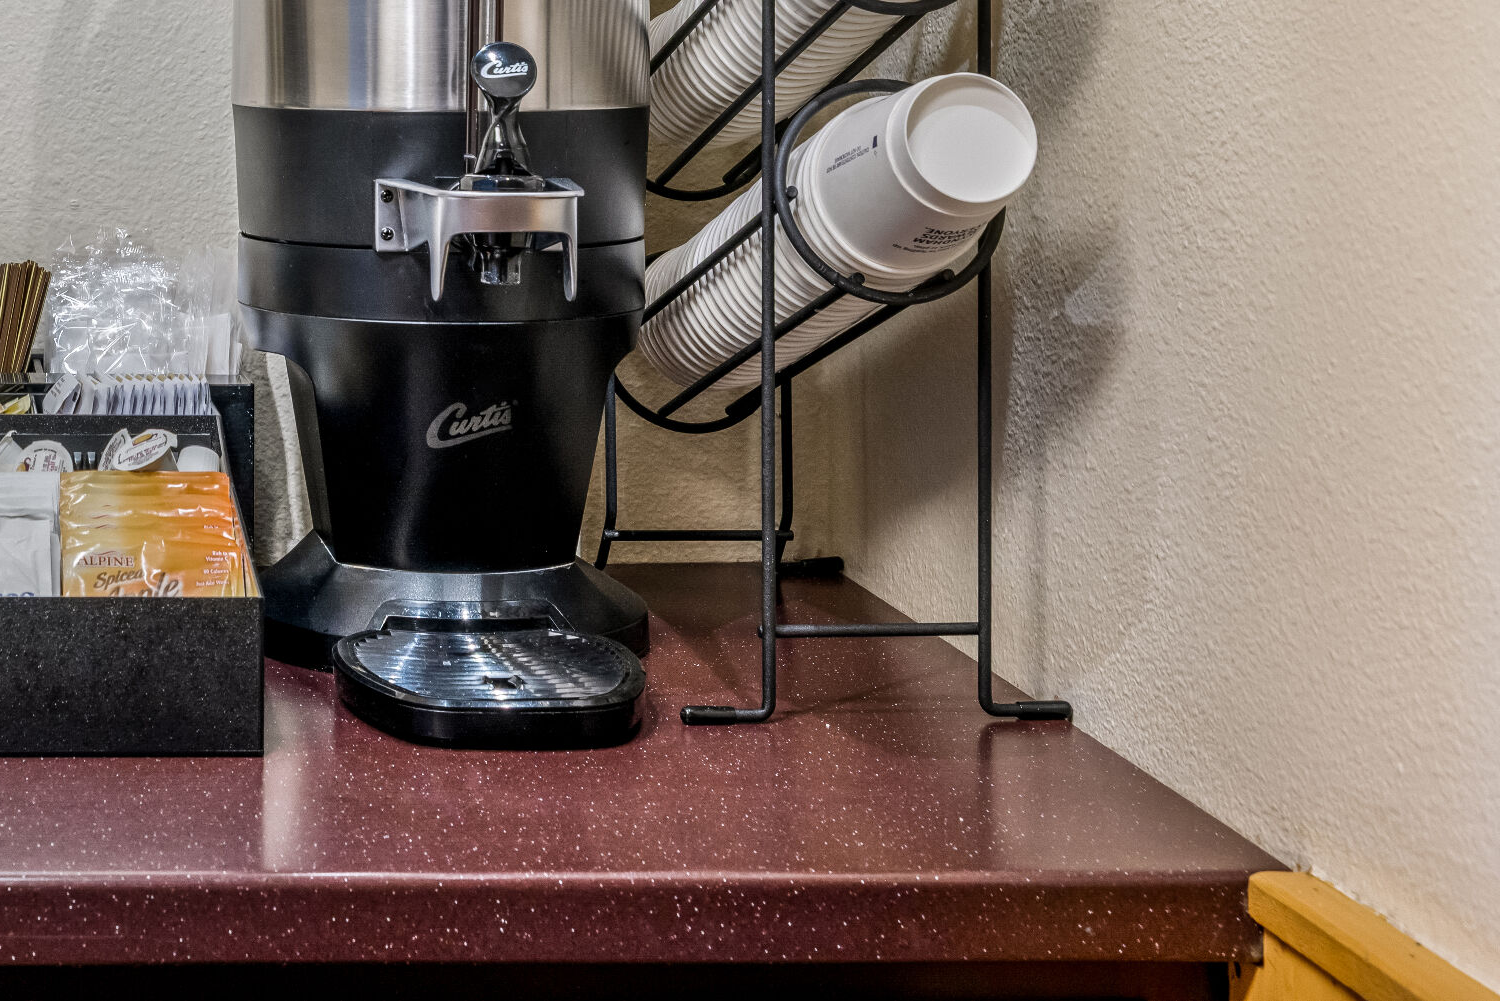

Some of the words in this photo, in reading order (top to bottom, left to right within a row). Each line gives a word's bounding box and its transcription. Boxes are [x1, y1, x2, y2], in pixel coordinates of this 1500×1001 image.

[481, 60, 529, 79] Curtis
[426, 401, 514, 449] Curtis
[78, 555, 134, 567] ALPINE
